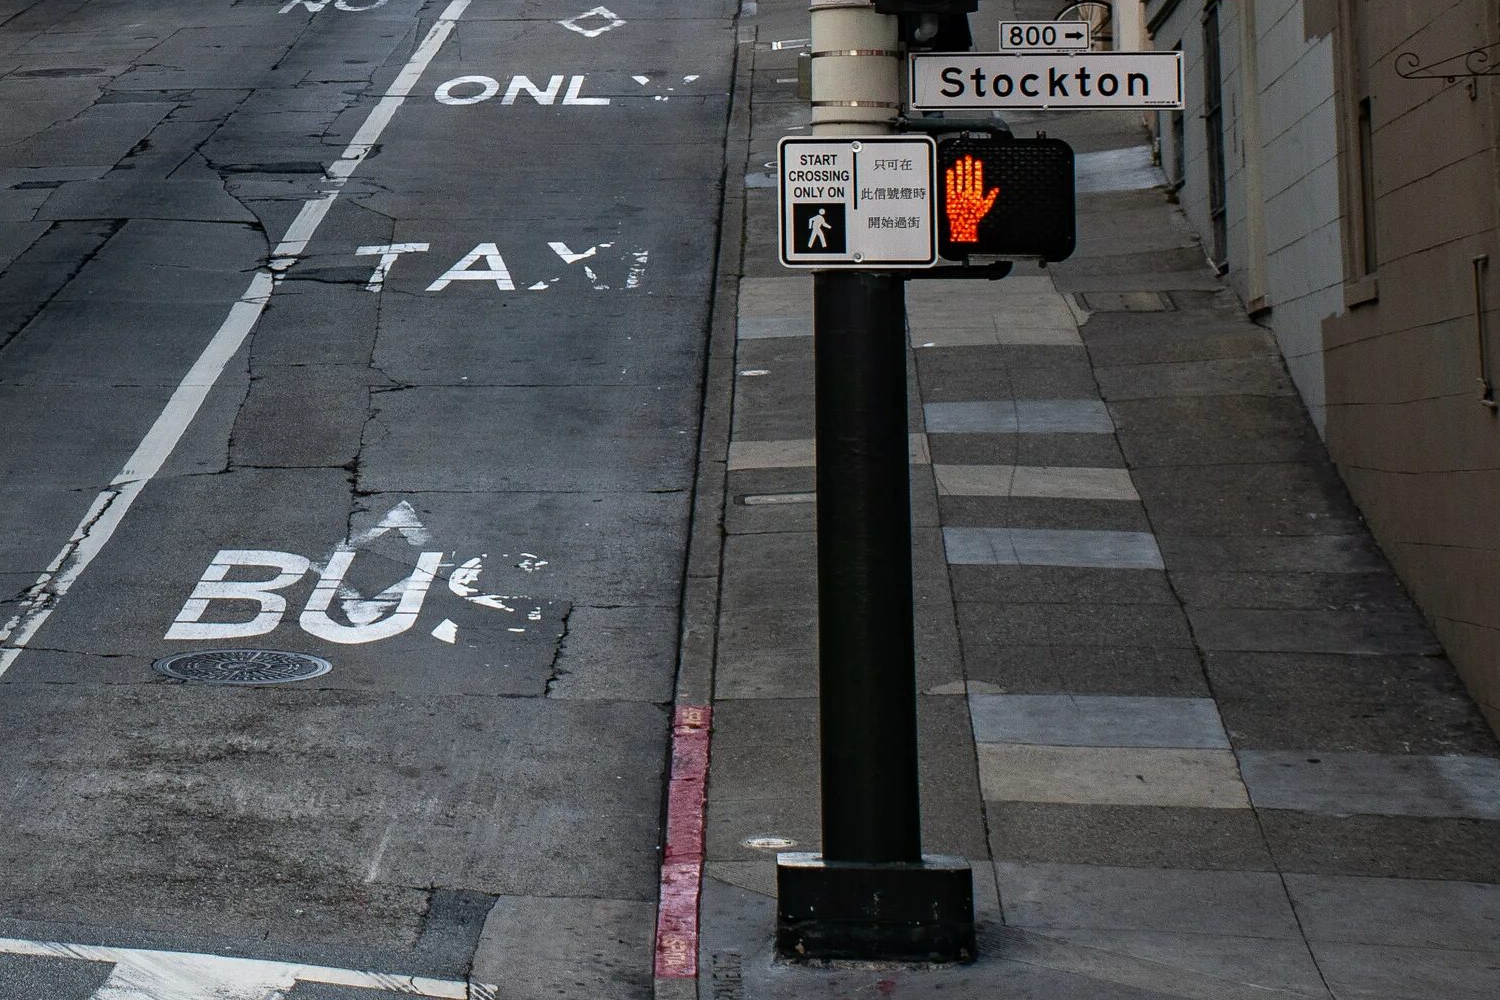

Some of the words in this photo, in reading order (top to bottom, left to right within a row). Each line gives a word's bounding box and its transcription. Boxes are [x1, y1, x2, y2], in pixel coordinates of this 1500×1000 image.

[1009, 26, 1057, 46] 800
[940, 66, 1150, 98] Stockton
[800, 154, 838, 166] START
[873, 158, 913, 172] 只可在
[788, 170, 850, 182] CROSSING
[793, 186, 824, 198] ONLY
[828, 186, 845, 198] ON
[861, 187, 927, 201] 此信號燈時
[867, 216, 920, 230] 開始過街
